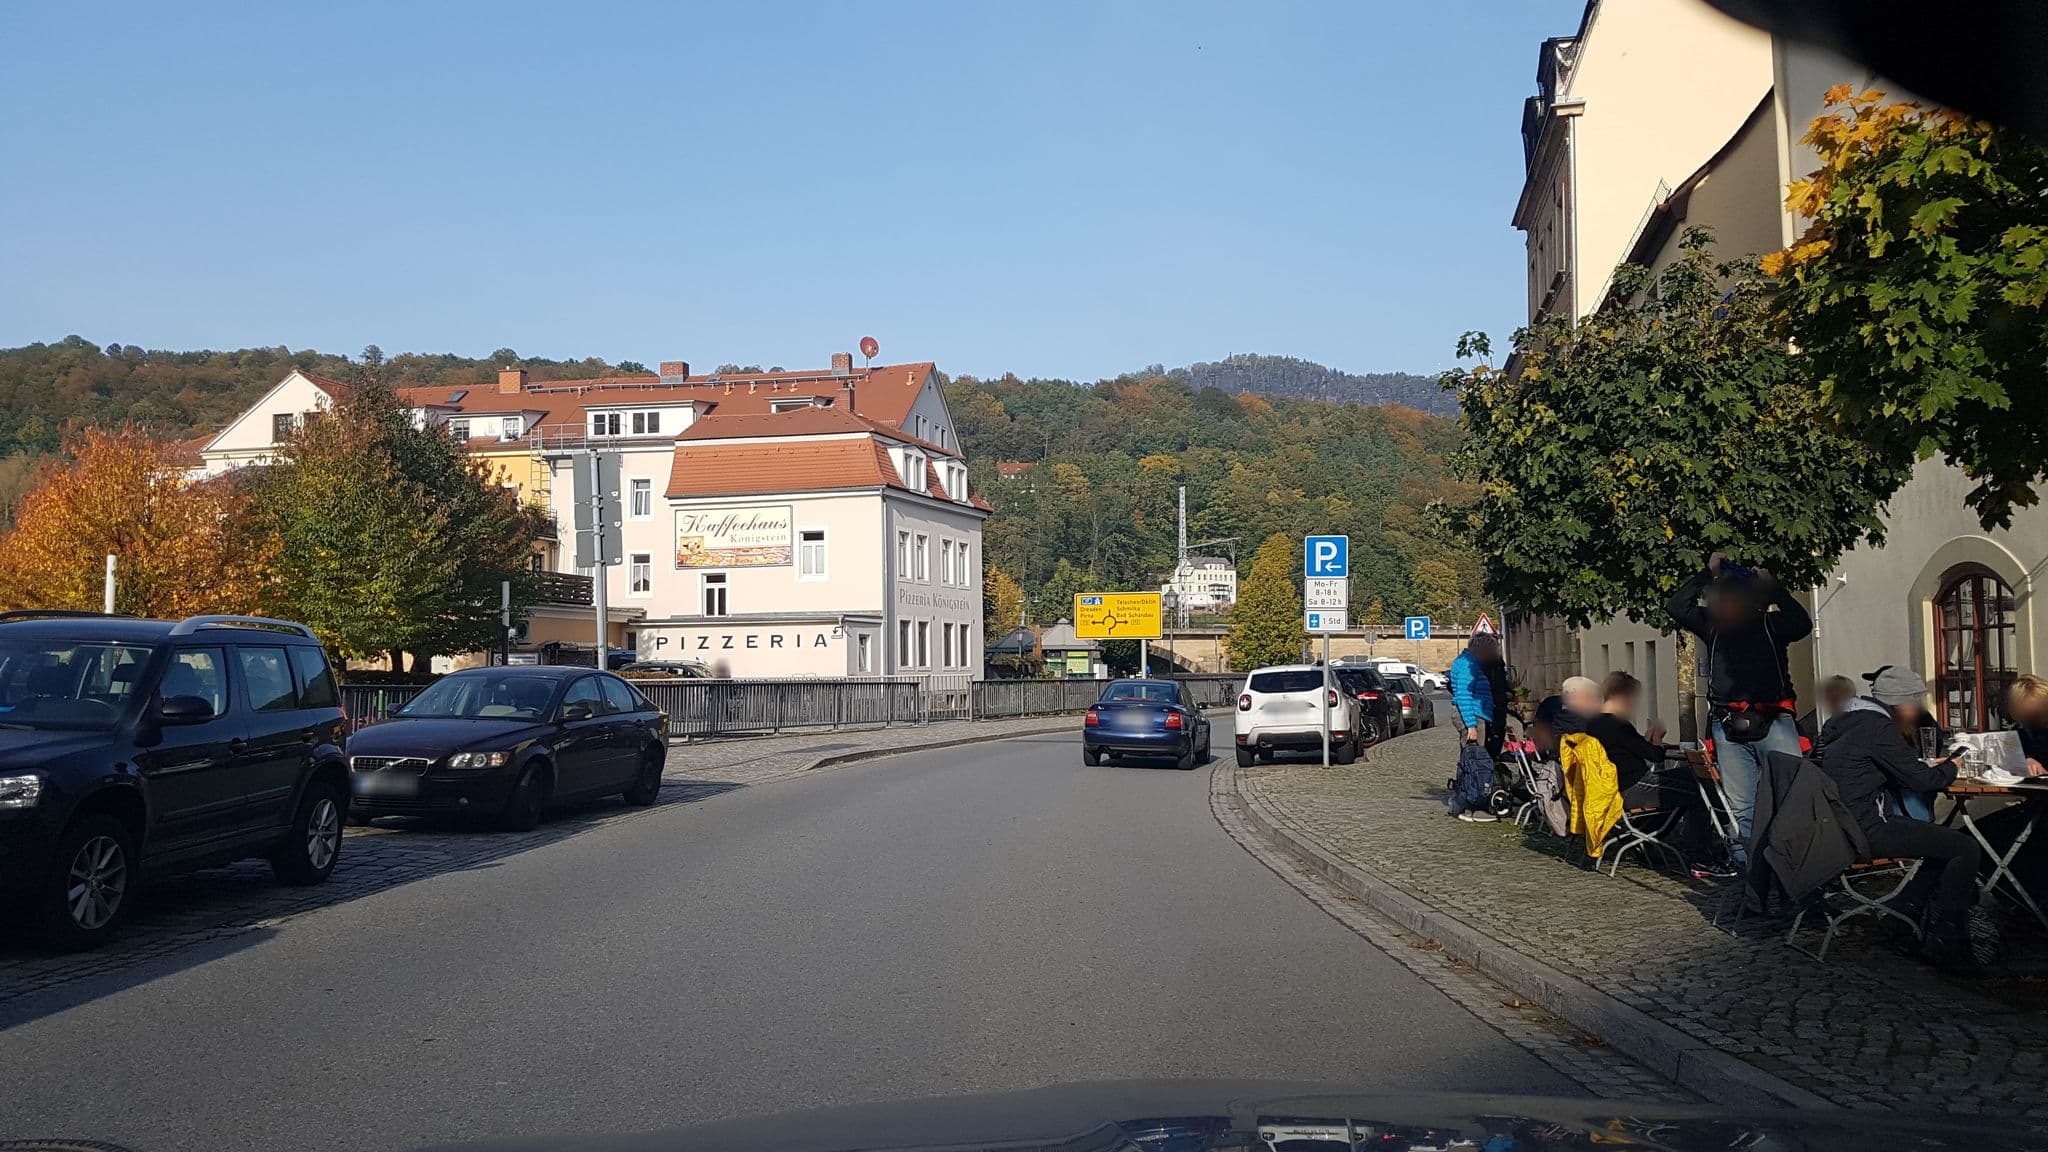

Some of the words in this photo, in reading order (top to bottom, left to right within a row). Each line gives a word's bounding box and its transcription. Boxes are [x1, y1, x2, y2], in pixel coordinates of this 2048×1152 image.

[680, 513, 787, 537] Kaffeehaus
[1316, 541, 1337, 572] P
[1328, 617, 1343, 625] Std.
[1411, 620, 1424, 637] P
[656, 633, 828, 650] PIZZERIA
